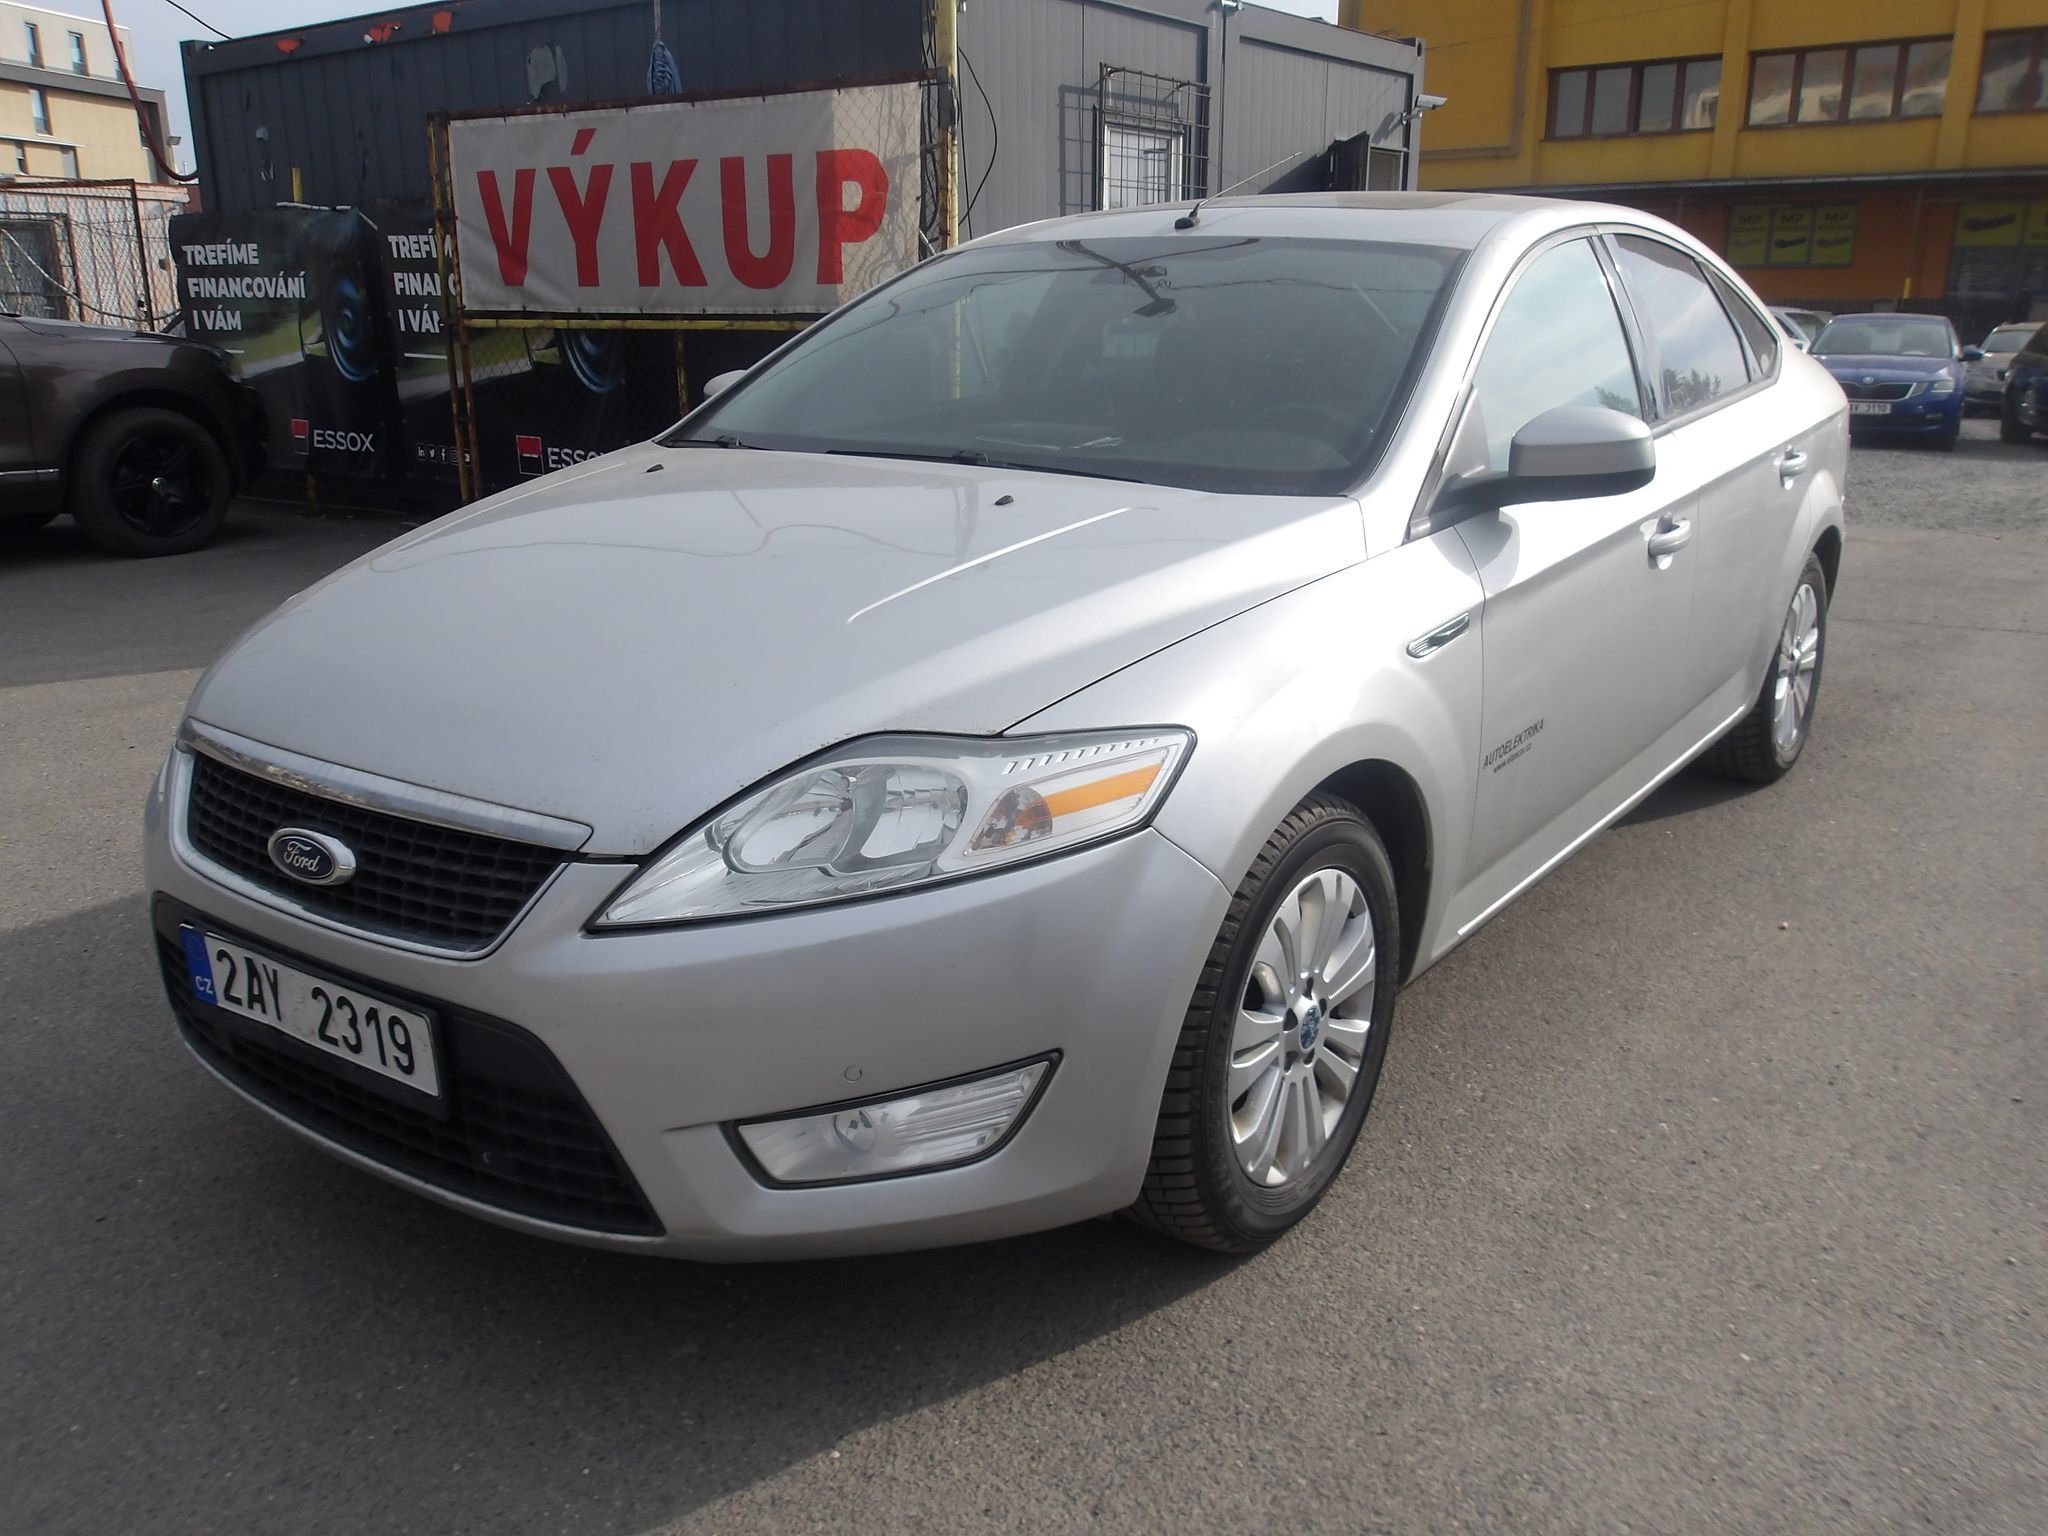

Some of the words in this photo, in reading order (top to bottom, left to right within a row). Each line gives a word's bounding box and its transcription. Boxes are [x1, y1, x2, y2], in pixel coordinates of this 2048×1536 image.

[476, 128, 889, 290] VÝKUP
[181, 238, 260, 265] TREFÍME
[187, 271, 306, 298] FINANCOVÁNÍ
[193, 310, 200, 330] I
[202, 305, 242, 331] VÁM
[398, 309, 406, 331] I
[313, 429, 375, 452] ESSOX
[547, 447, 604, 469] ESSO
[283, 840, 320, 872] Ford
[195, 975, 214, 995] CZ
[216, 949, 283, 1023] 2AY
[311, 986, 416, 1076] 2319
